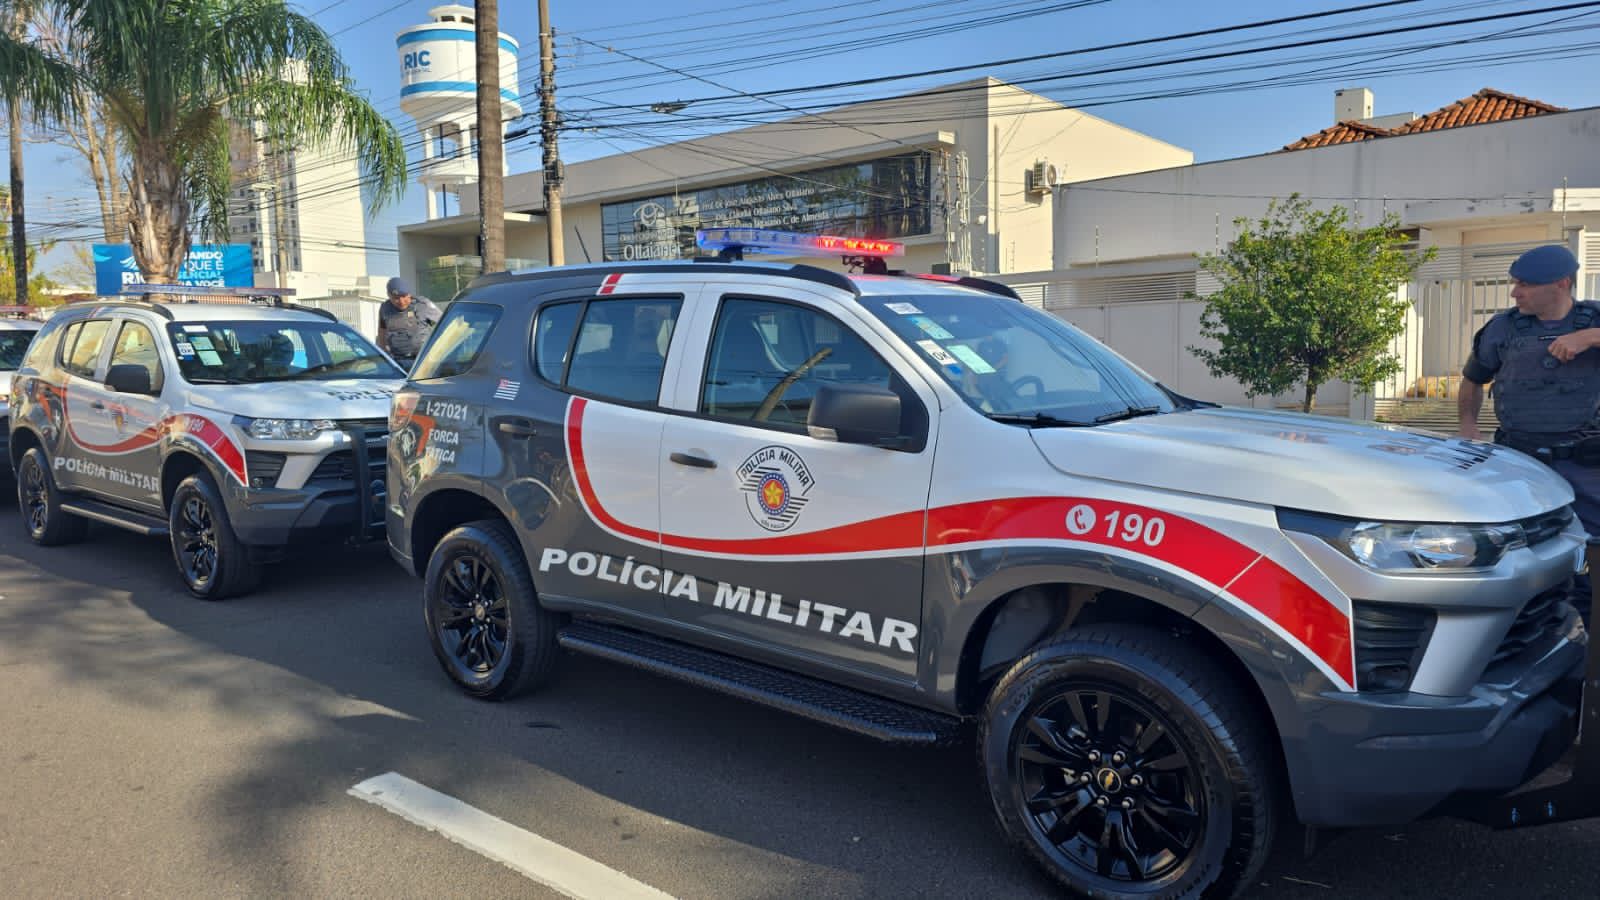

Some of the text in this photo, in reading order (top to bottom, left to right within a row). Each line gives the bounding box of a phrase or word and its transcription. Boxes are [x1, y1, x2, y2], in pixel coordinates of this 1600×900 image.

[404, 50, 431, 70] RIC
[767, 191, 784, 201] Alves
[785, 187, 815, 198] Ottaiano
[791, 215, 800, 223] de
[184, 260, 213, 271] QUE
[426, 401, 468, 421] I-27021
[779, 450, 809, 487] MILITAR
[109, 467, 160, 492] MILITAR
[1104, 510, 1166, 547] 190
[538, 547, 919, 654] POLÍCIA MILITAR
